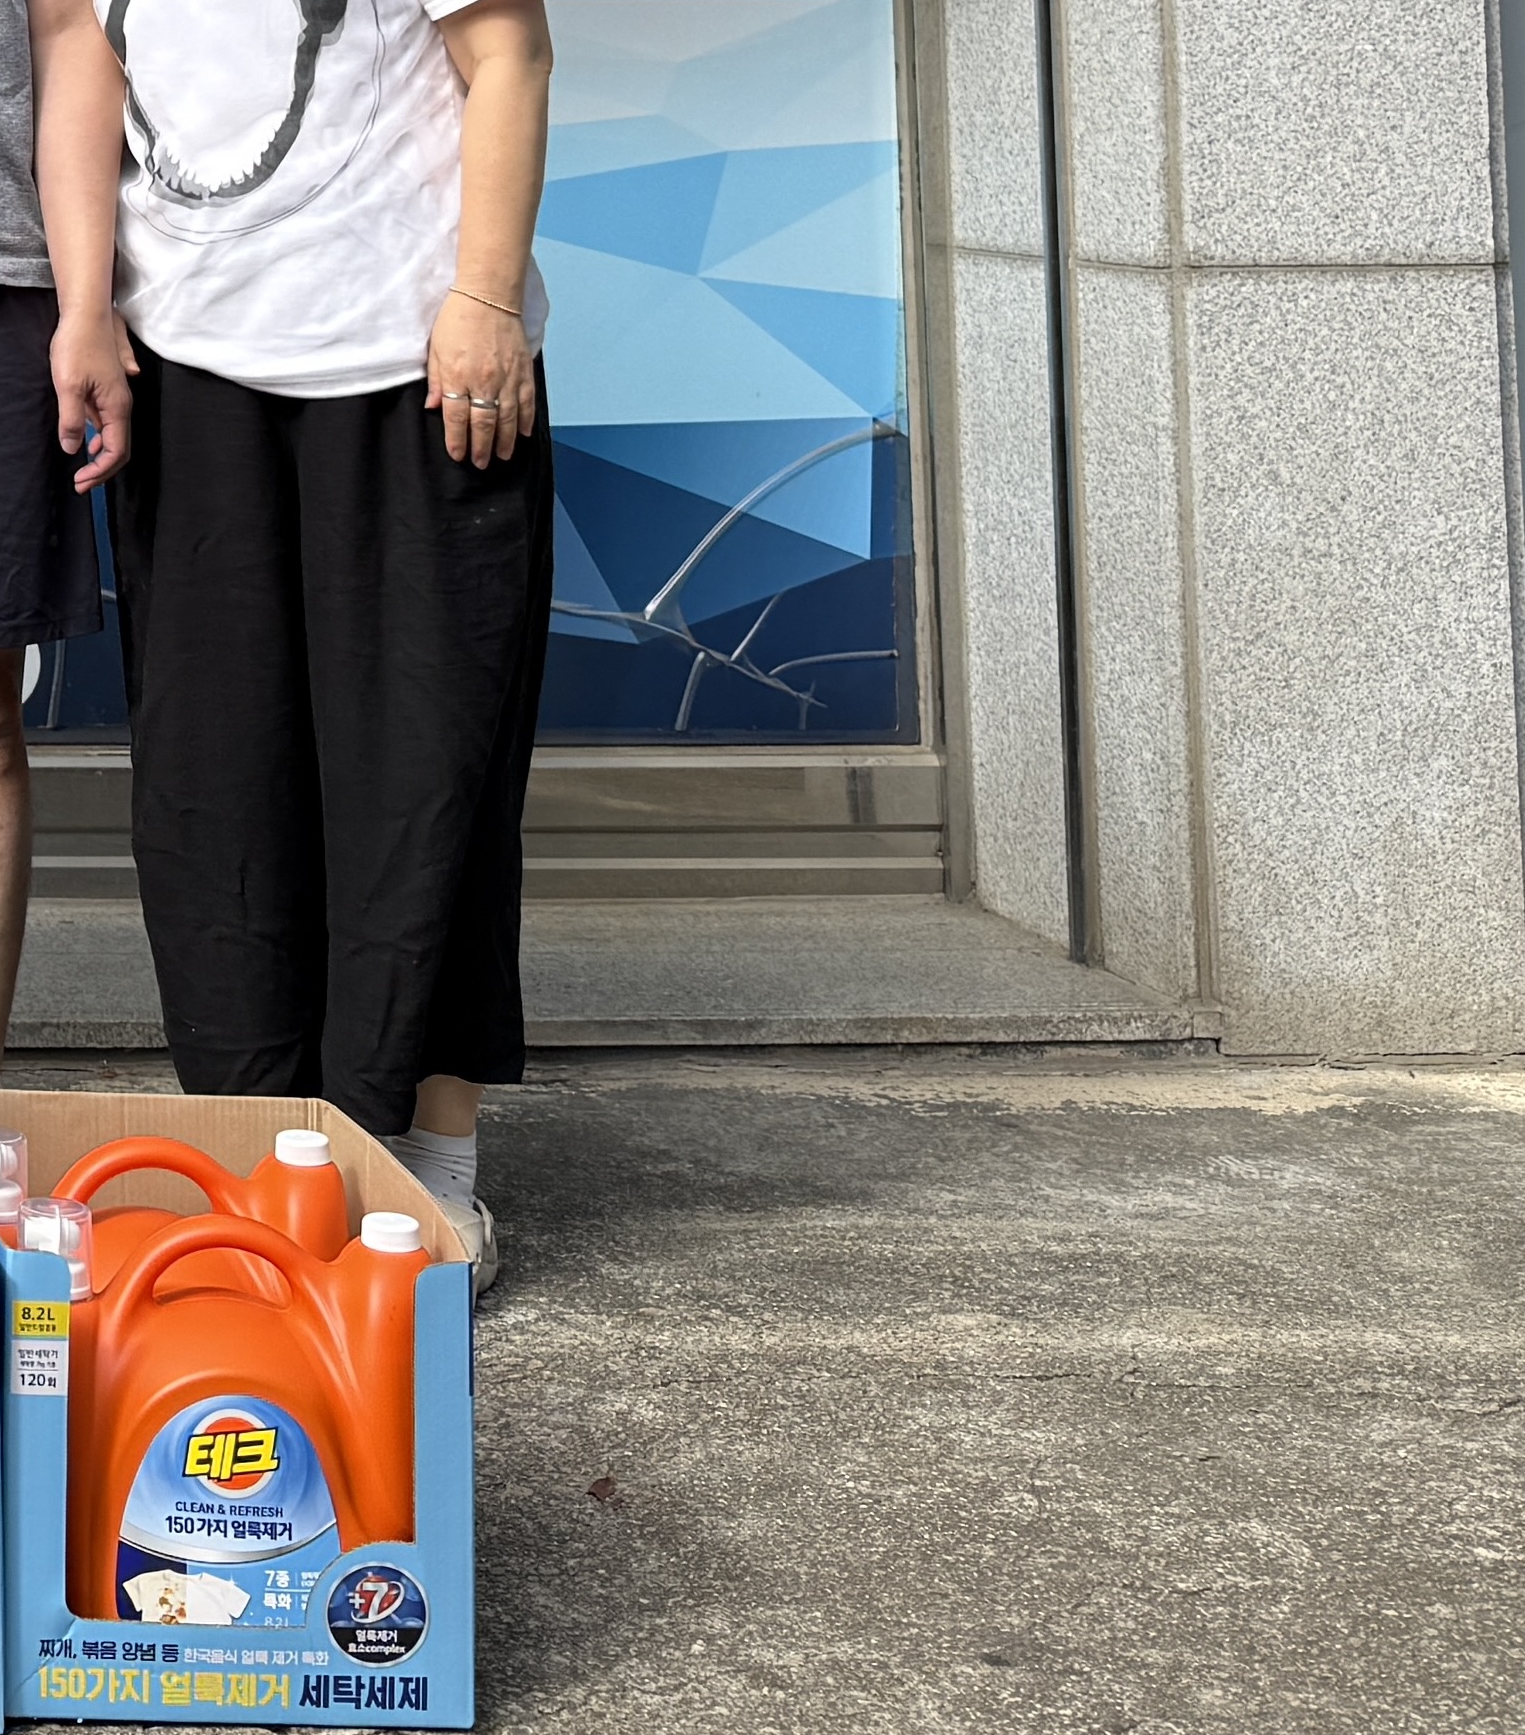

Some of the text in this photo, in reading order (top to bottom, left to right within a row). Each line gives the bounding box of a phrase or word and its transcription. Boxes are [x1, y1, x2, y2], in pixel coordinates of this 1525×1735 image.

[21, 1307, 55, 1321] 8.2L
[182, 1427, 281, 1482] 테크
[175, 1501, 284, 1518] CLEAN & REFRESH
[165, 1516, 293, 1541] 150가지 얼룩제거
[38, 1638, 77, 1659] 찌개,
[82, 1639, 118, 1661] 볶음
[122, 1642, 156, 1663] 양념
[161, 1643, 179, 1663] 등
[272, 1649, 299, 1665] 제거
[38, 1666, 429, 1711] 150가지 얼룩제거 세탁세제
